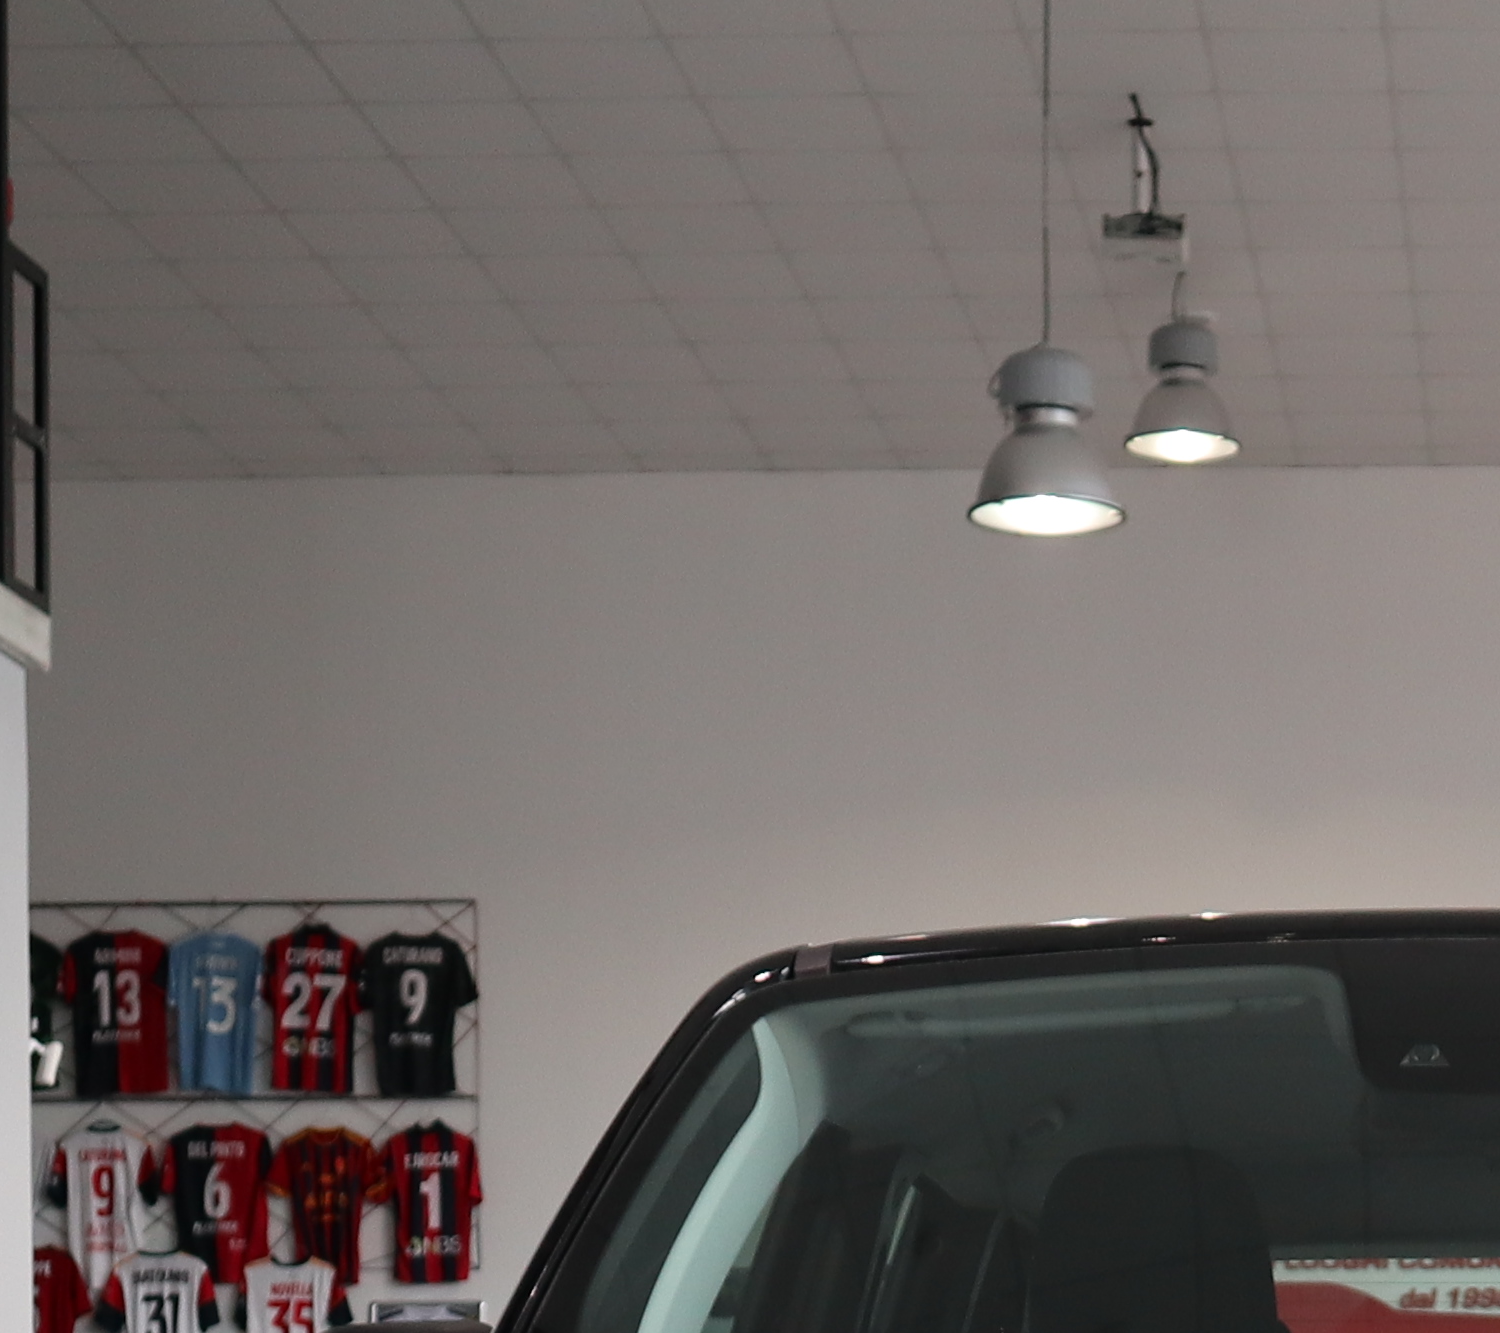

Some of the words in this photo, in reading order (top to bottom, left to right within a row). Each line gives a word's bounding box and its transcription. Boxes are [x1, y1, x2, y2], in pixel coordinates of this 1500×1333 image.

[92, 968, 142, 1027] 13
[191, 974, 238, 1035] 13
[280, 971, 347, 1032] 27
[399, 968, 429, 1025] 9
[92, 1164, 114, 1217] 9
[203, 1162, 232, 1219] 6
[418, 1171, 442, 1230] 1
[1399, 1287, 1437, 1309] dal
